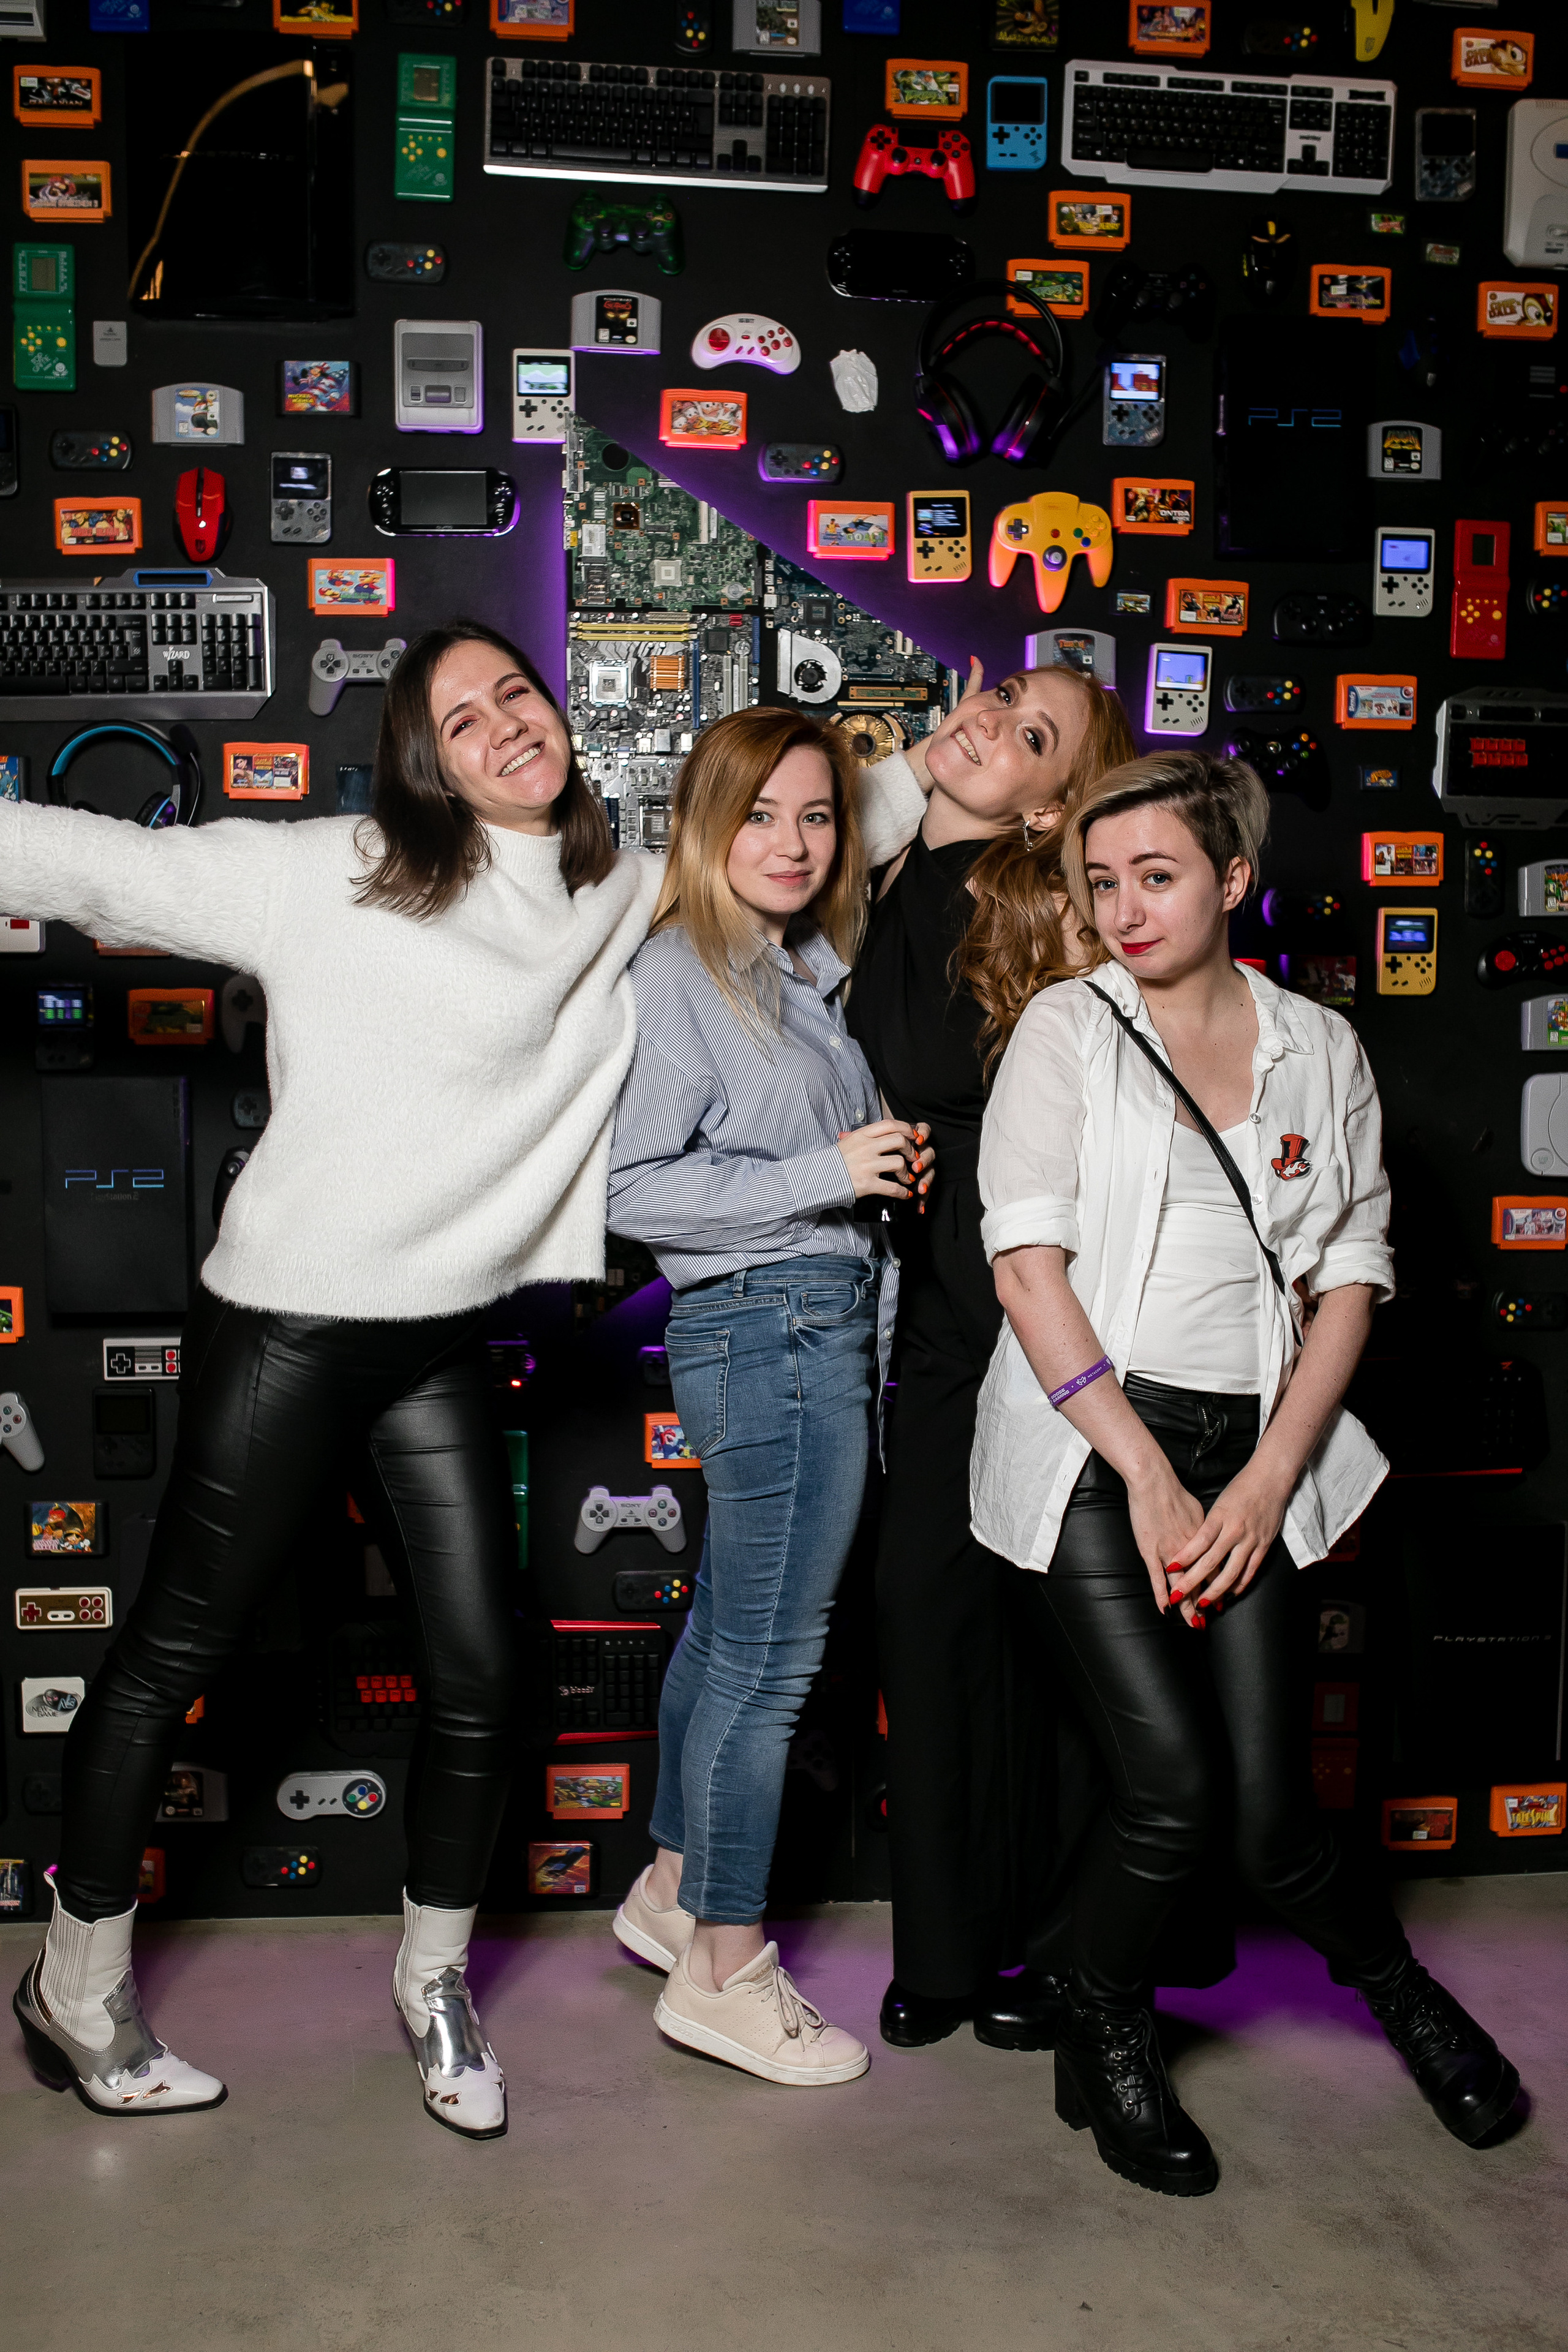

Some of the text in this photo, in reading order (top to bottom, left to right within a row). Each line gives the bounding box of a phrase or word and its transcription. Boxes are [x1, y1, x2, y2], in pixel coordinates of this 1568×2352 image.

[1248, 407, 1342, 428] PS2
[1159, 509, 1191, 518] ONTRA
[846, 532, 877, 543] GOAL
[163, 646, 190, 660] WIZARD
[66, 1170, 164, 1188] PS2
[1050, 1387, 1066, 1400] GOOSE
[1052, 1389, 1070, 1403] GAMING
